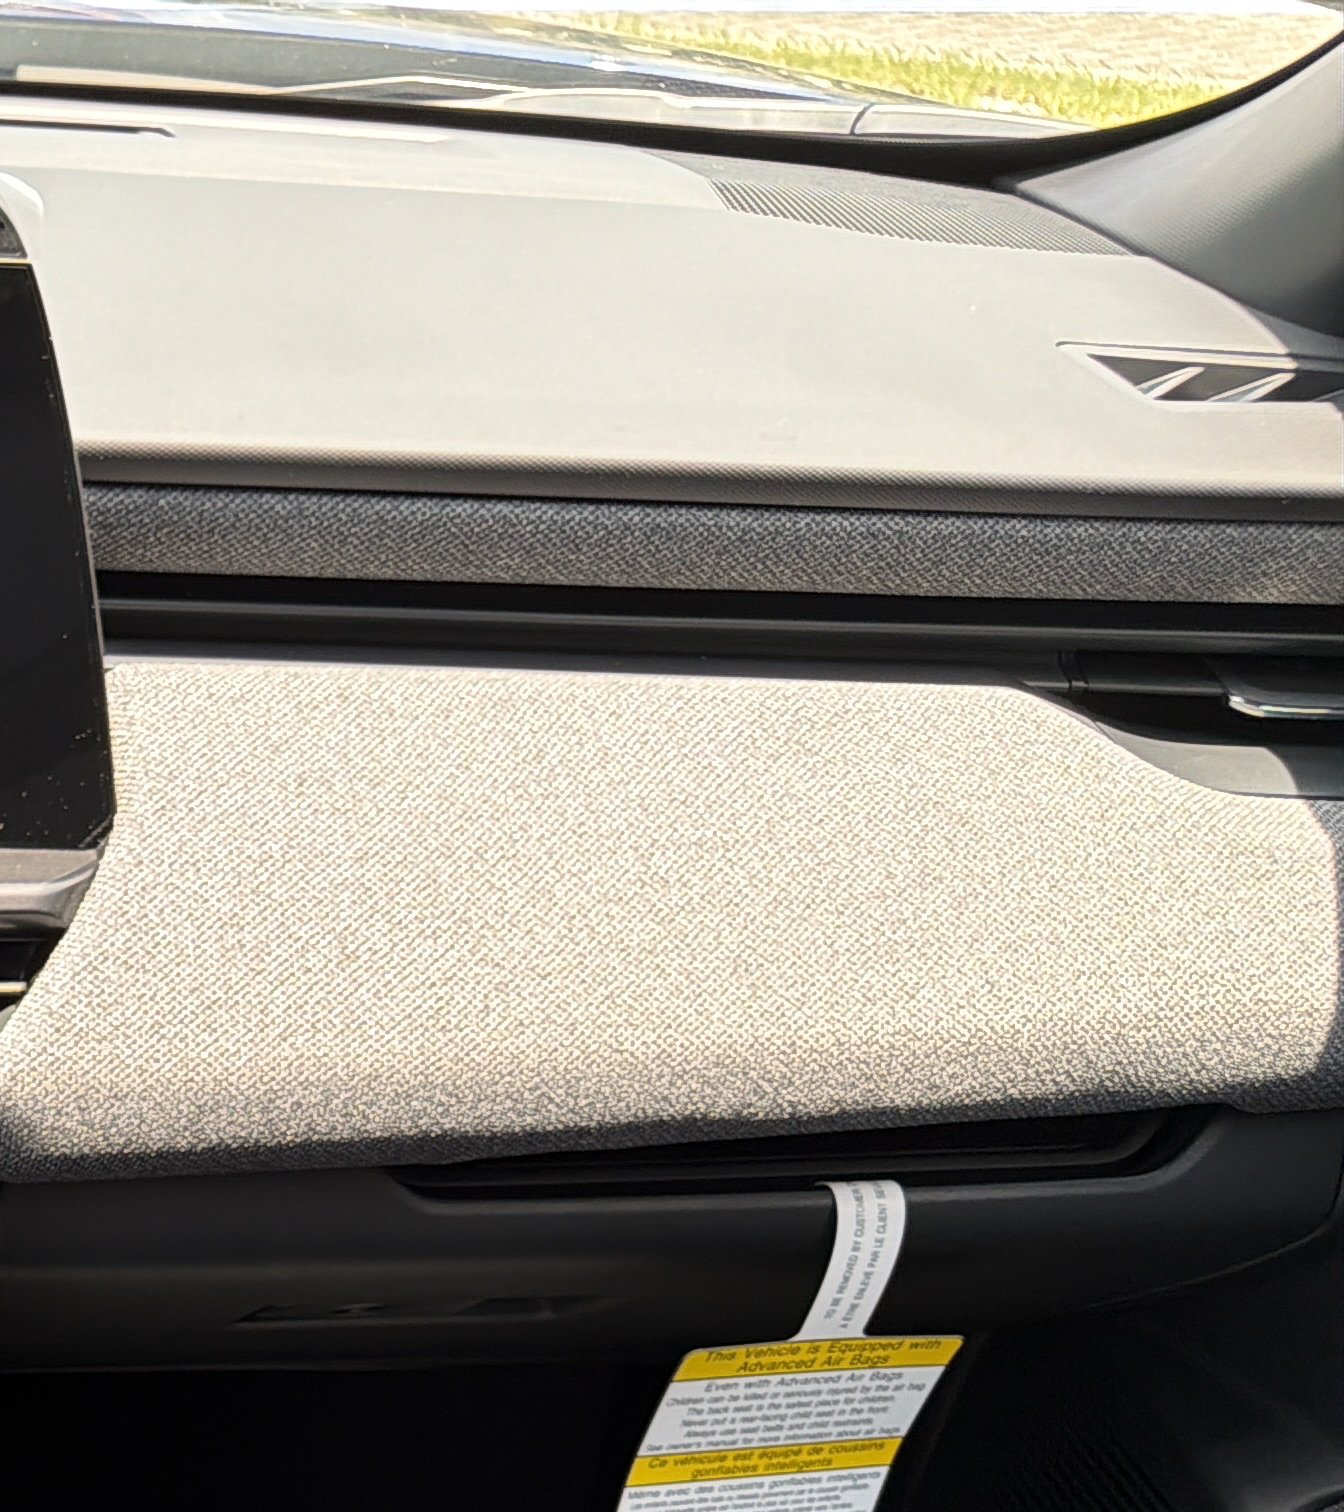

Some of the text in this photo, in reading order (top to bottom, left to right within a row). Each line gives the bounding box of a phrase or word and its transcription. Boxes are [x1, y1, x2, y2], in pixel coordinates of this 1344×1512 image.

[705, 1340, 942, 1362] This Vehicle is Equipped with
[736, 1353, 890, 1373] Advanced Air Bags
[704, 1371, 904, 1392] Even with Advanced Air Bags
[647, 1441, 885, 1469] Ce véhicule est équipé de coussins
[690, 1457, 833, 1479] gonflables intelligents
